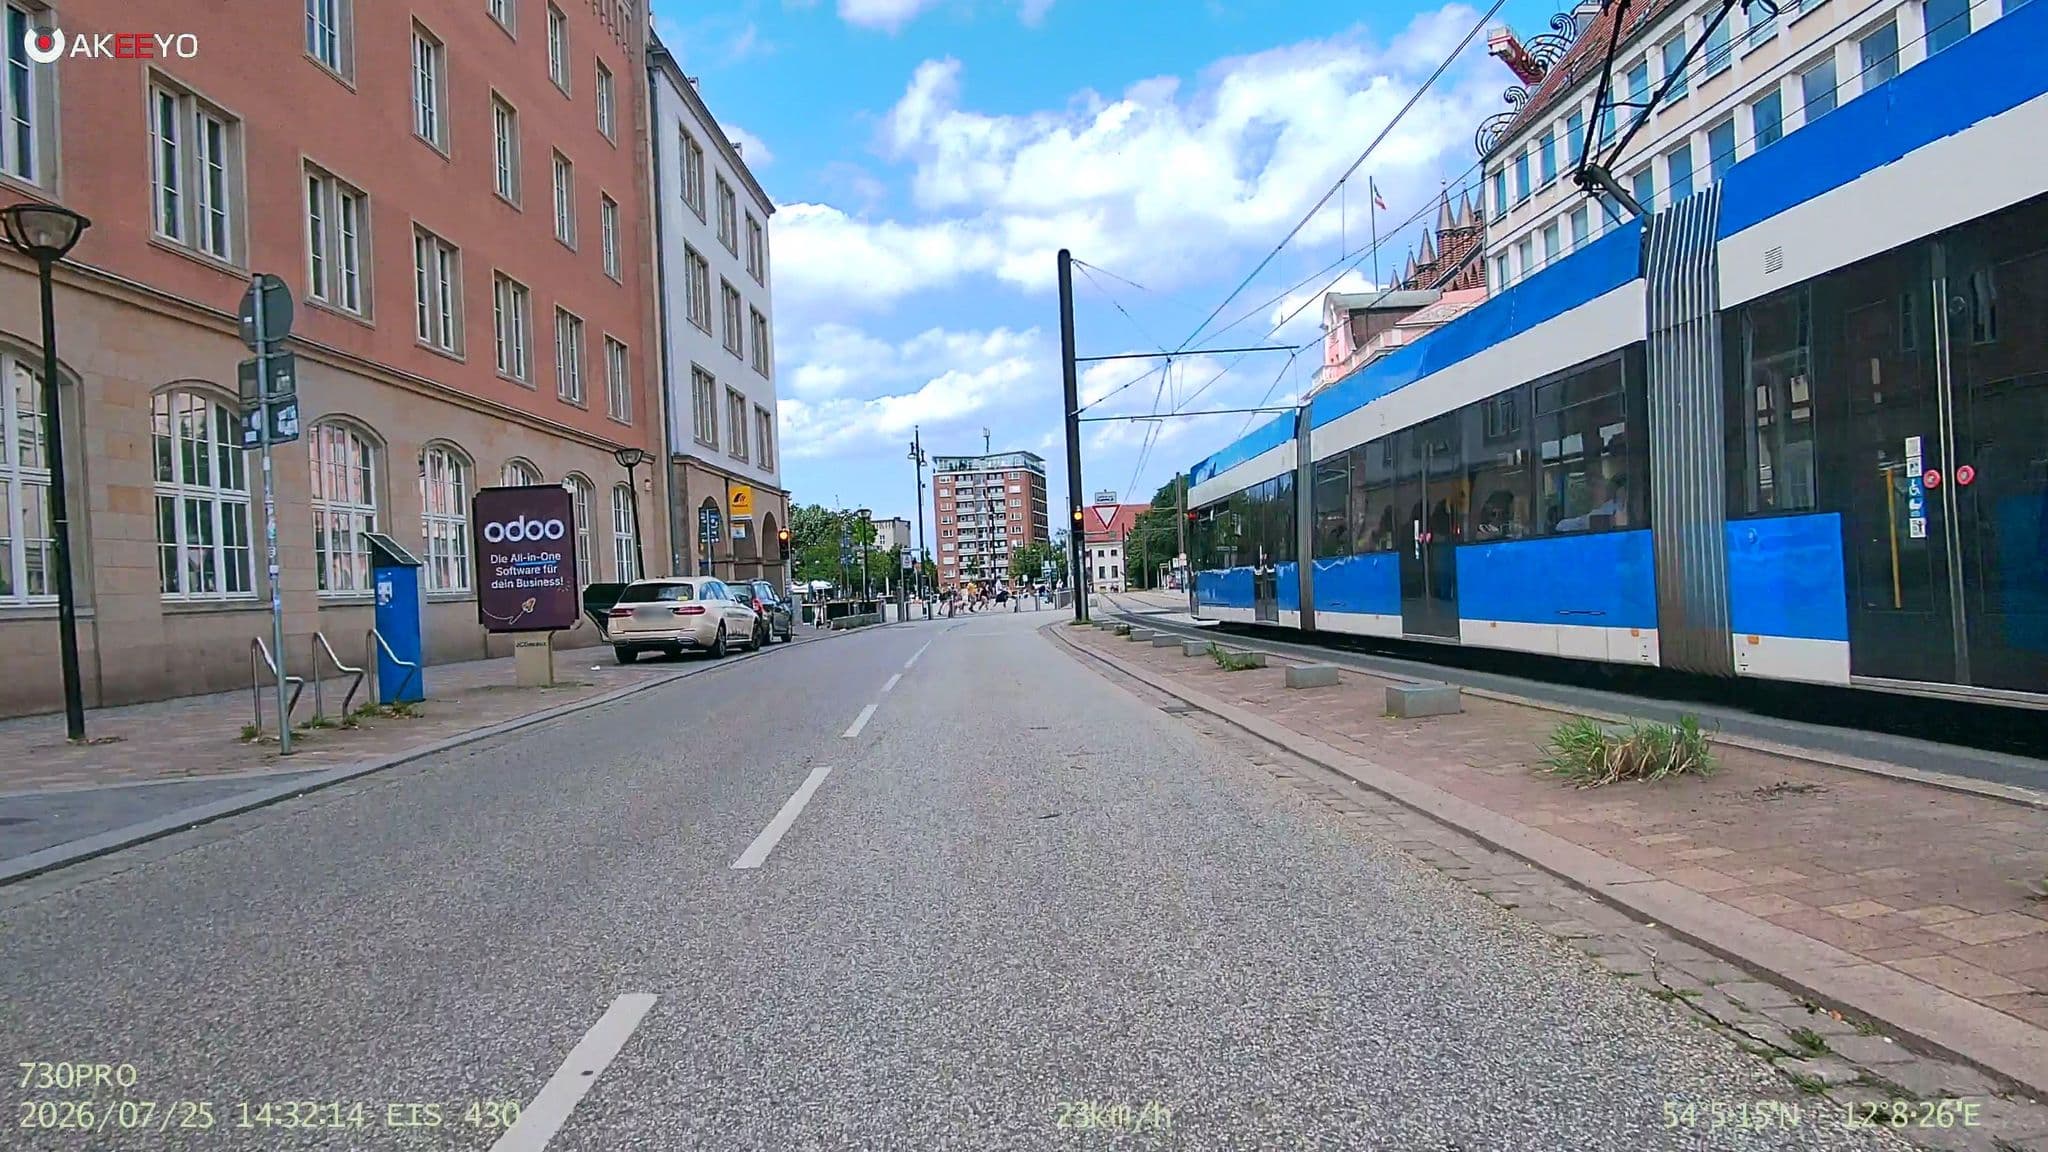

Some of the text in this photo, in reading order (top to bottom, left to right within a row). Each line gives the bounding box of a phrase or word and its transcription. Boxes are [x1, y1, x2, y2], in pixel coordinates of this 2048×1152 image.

[484, 515, 565, 543] odoo
[490, 552, 561, 564] Die All-in-One
[495, 564, 558, 576] Software für
[491, 576, 564, 589] dein Business!
